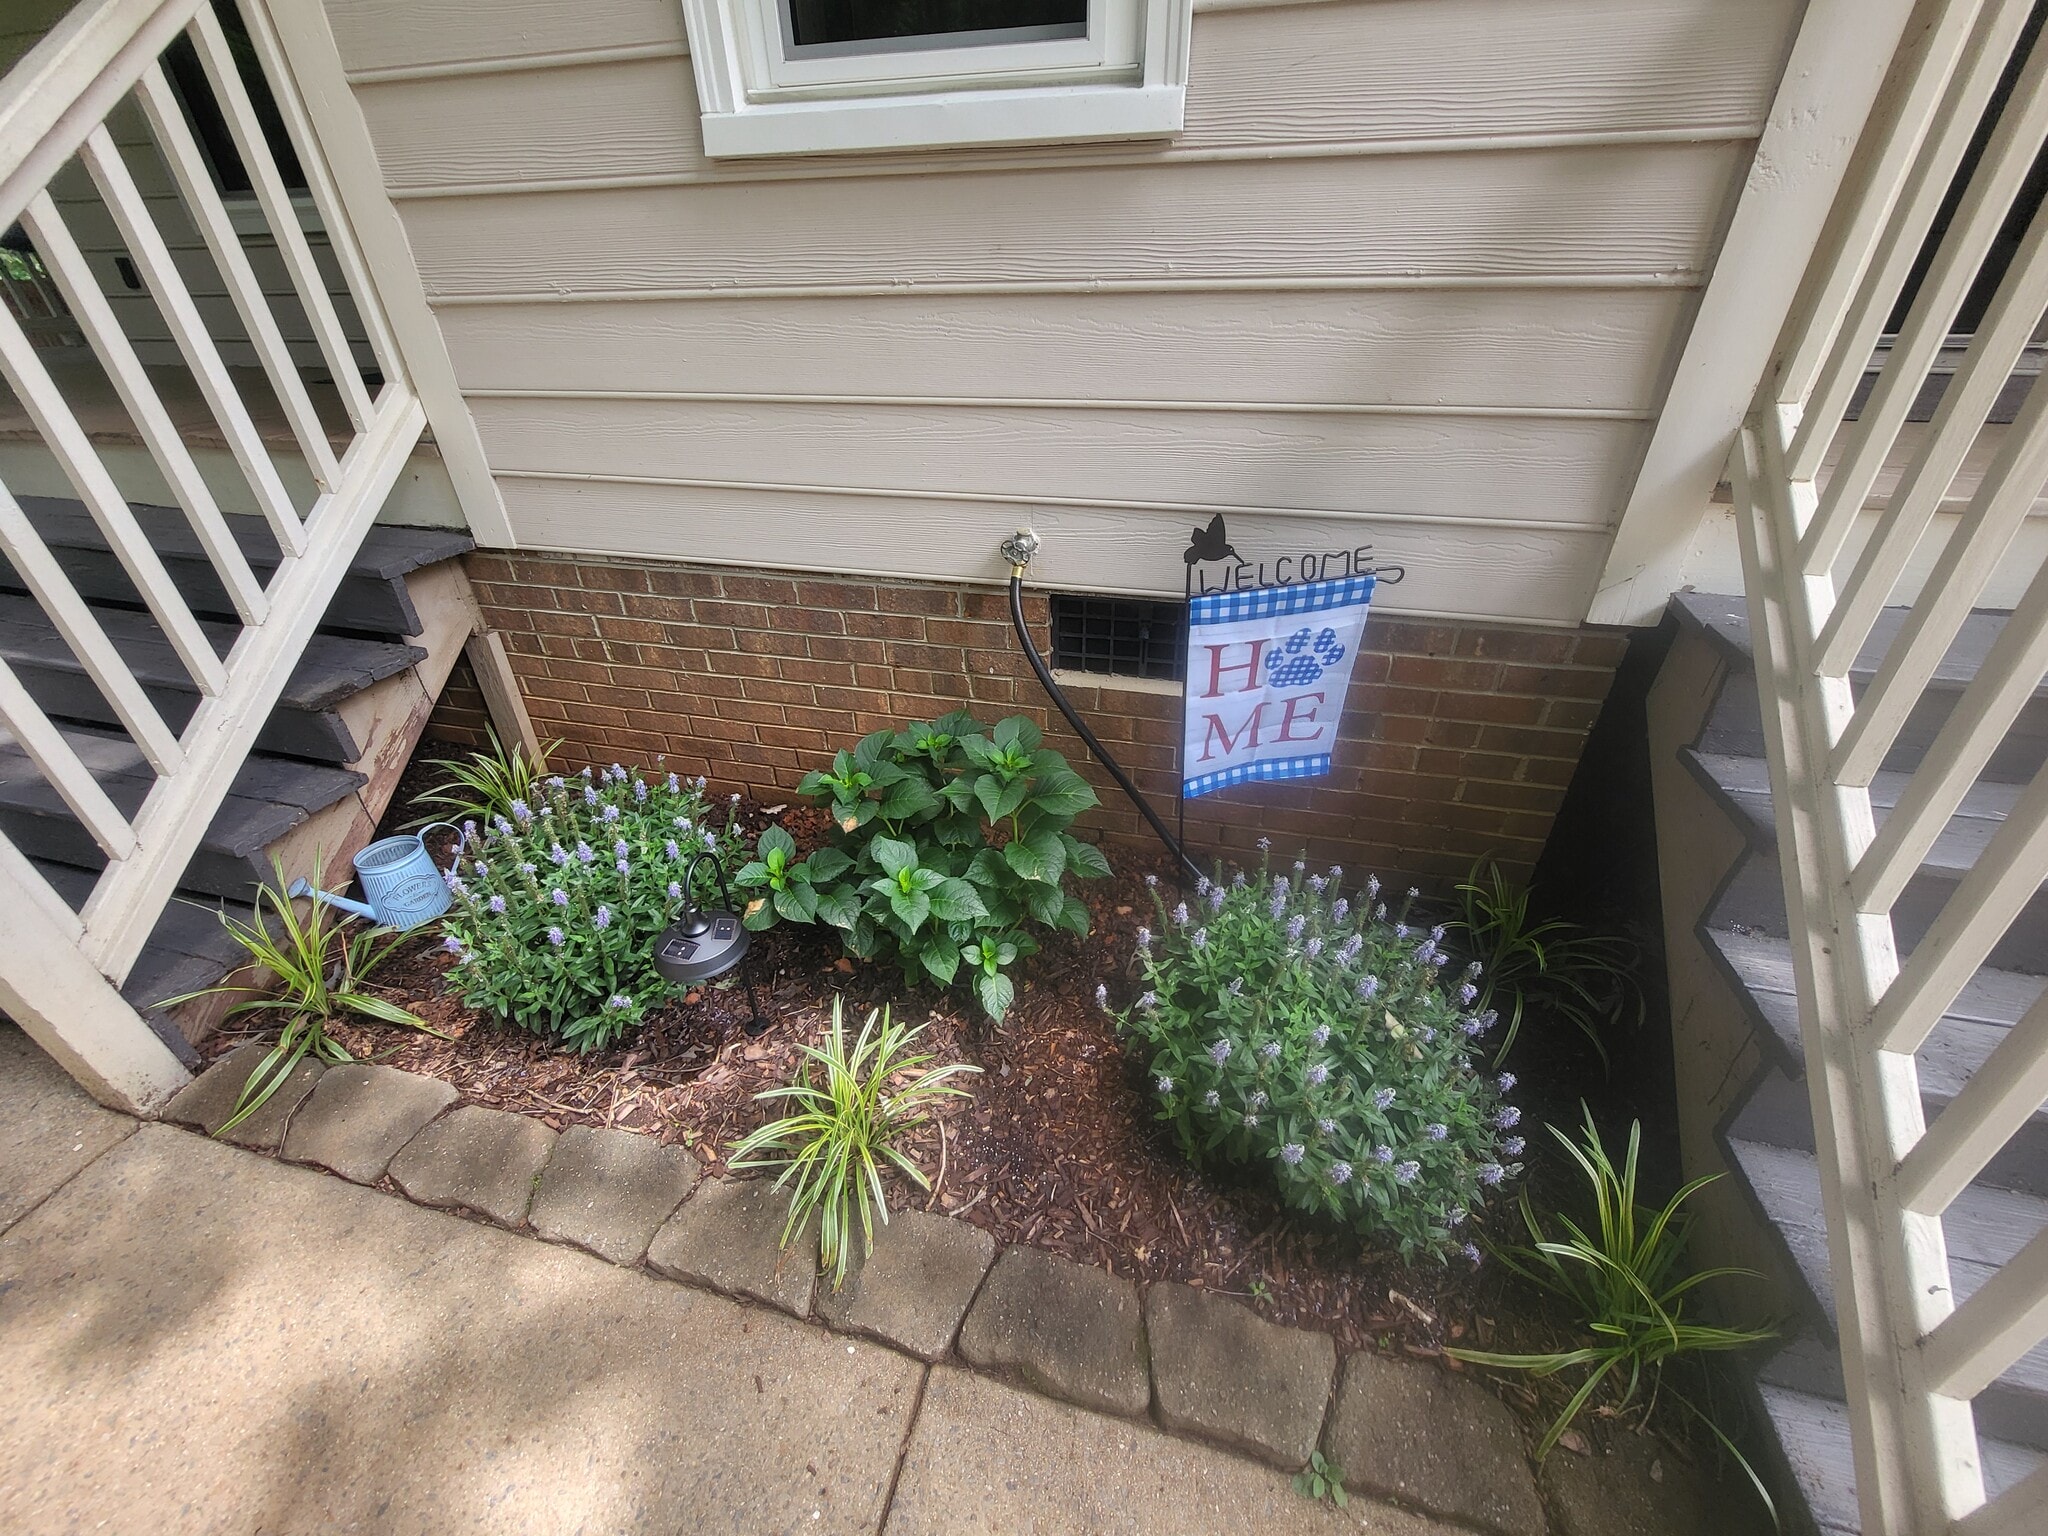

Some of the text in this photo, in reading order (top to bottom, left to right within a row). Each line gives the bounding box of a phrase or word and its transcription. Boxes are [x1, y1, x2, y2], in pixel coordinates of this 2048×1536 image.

[1199, 544, 1373, 595] WELCOME
[1196, 692, 1325, 763] ME
[404, 891, 432, 907] GARDEN
